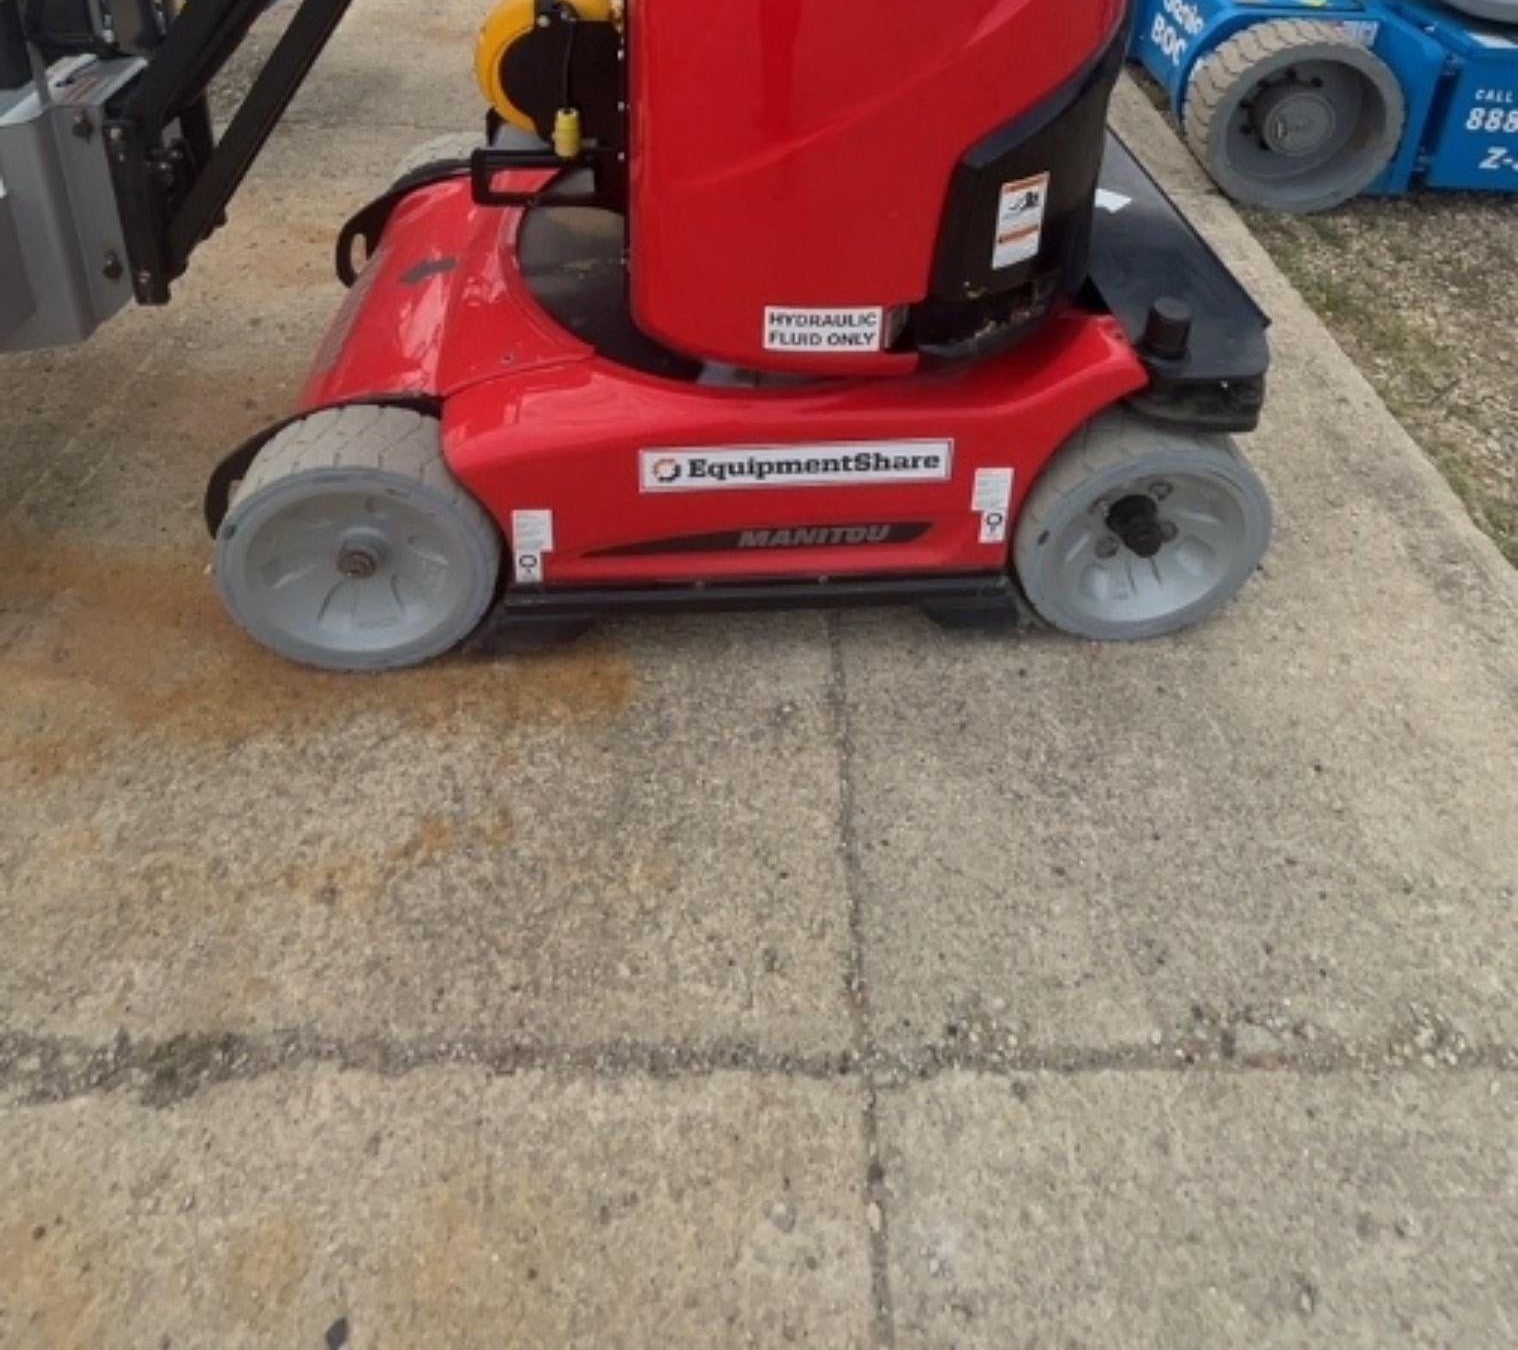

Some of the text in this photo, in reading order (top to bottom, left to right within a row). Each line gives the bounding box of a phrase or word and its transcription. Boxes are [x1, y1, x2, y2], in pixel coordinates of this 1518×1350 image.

[1474, 88, 1513, 103] CALL
[768, 311, 877, 328] HYDRAULIC
[768, 330, 876, 346] FLUID ONLY
[687, 452, 941, 480] EquipmentShare
[737, 524, 892, 547] MANITOU
